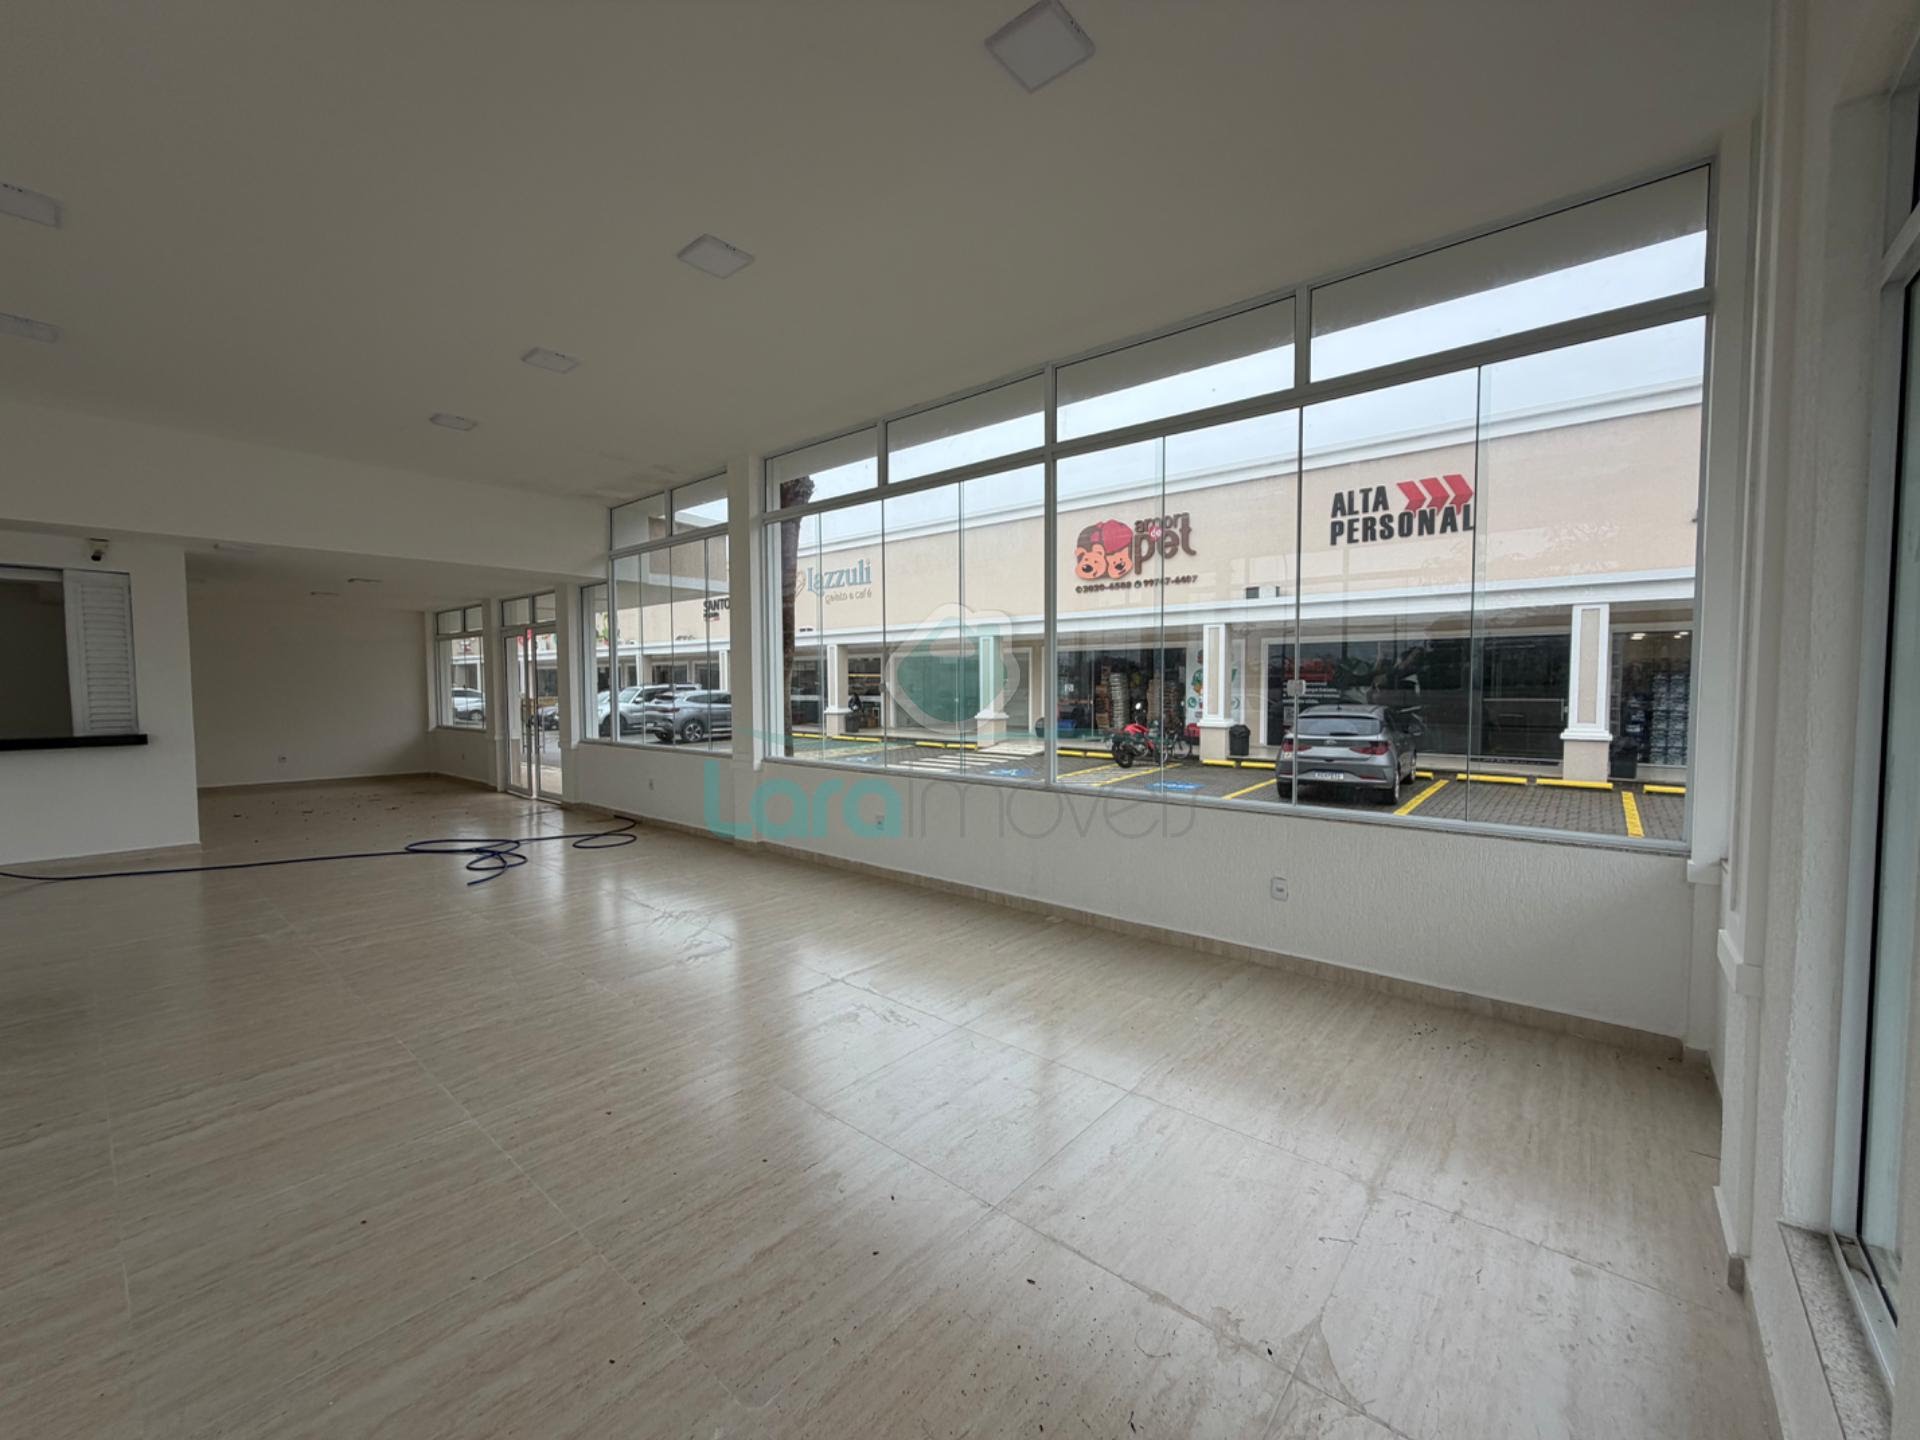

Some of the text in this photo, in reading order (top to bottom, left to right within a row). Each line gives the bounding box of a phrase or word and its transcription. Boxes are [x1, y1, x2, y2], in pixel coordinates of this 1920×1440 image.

[1331, 485, 1389, 518] ALTA
[1134, 512, 1197, 575] pet
[1330, 504, 1475, 546] PERSONAL
